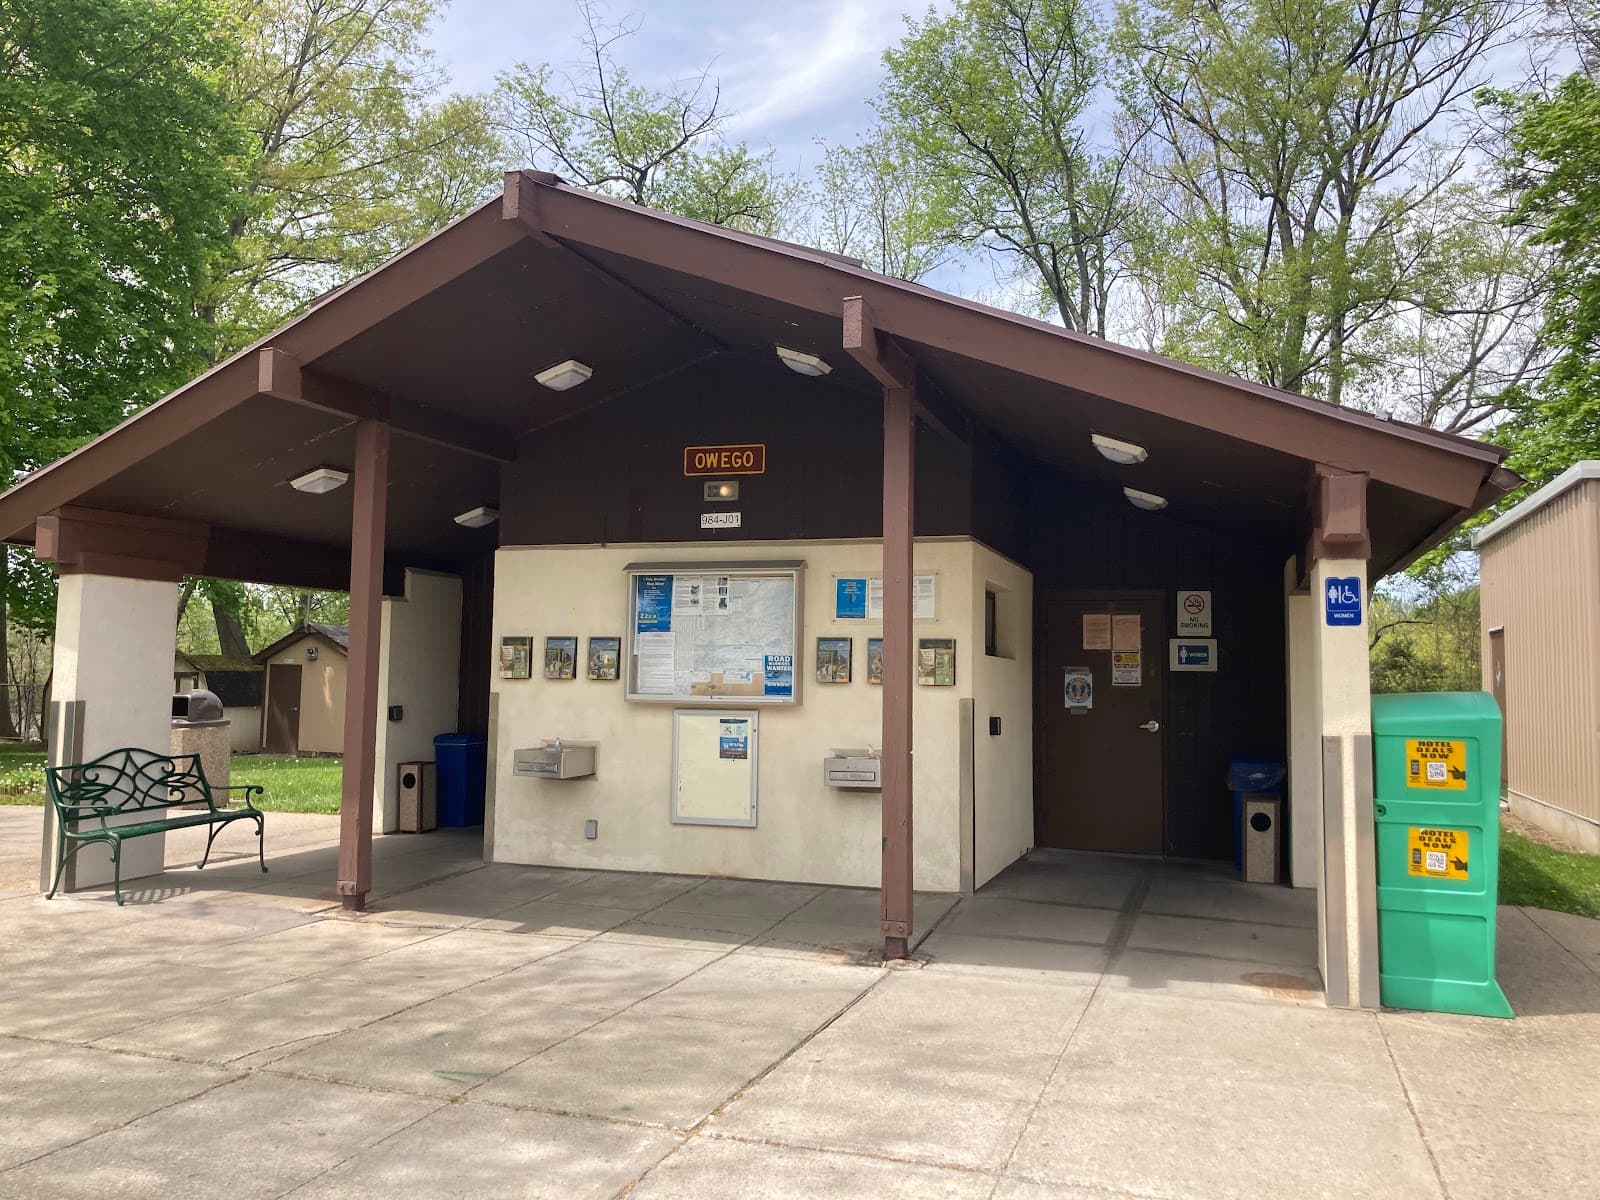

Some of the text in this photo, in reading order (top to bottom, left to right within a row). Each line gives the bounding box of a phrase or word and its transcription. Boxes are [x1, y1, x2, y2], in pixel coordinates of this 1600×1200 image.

[695, 451, 754, 469] OWEGO
[701, 514, 740, 525] 984-J01
[1420, 830, 1454, 838] HOTEL
[1418, 835, 1457, 844] DEALS
[1423, 842, 1452, 850] NOW
